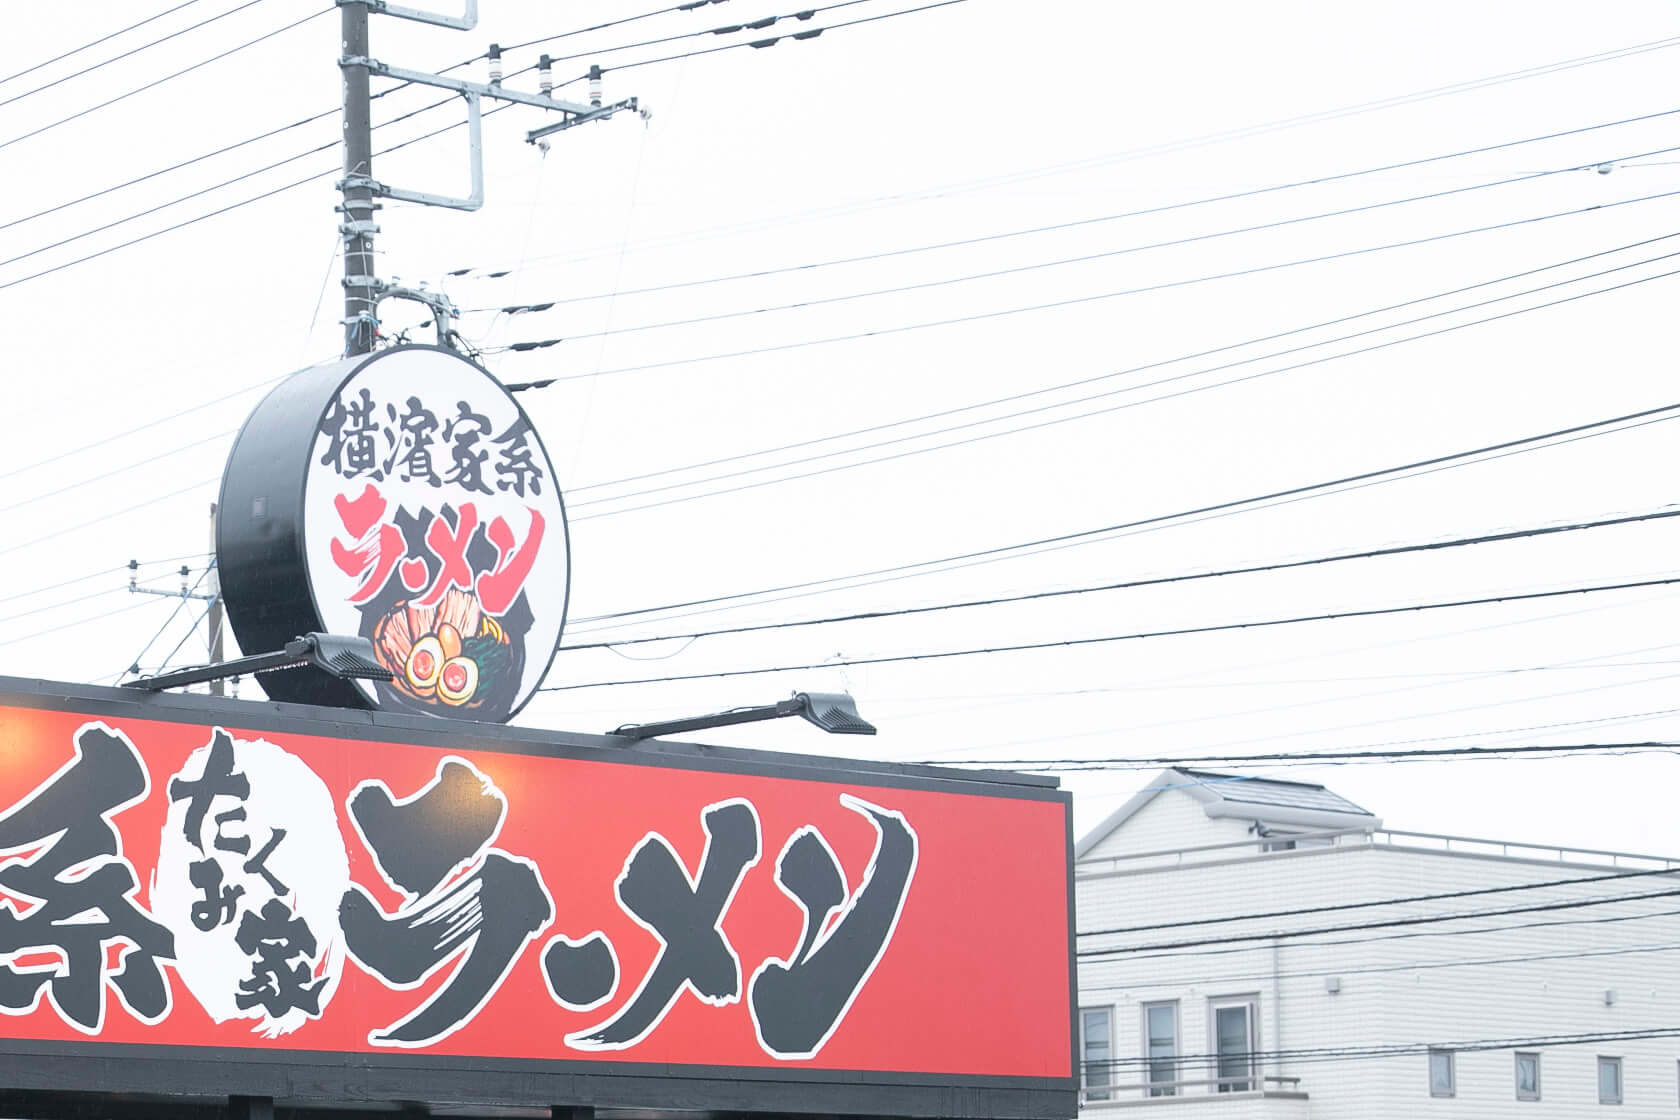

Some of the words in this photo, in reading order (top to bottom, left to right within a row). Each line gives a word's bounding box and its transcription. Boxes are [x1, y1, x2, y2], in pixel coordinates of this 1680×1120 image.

[320, 388, 543, 498] 横濱家系
[330, 483, 546, 617] ラーメン
[170, 726, 332, 1020] たくみ家
[338, 755, 920, 1061] ラーメン
